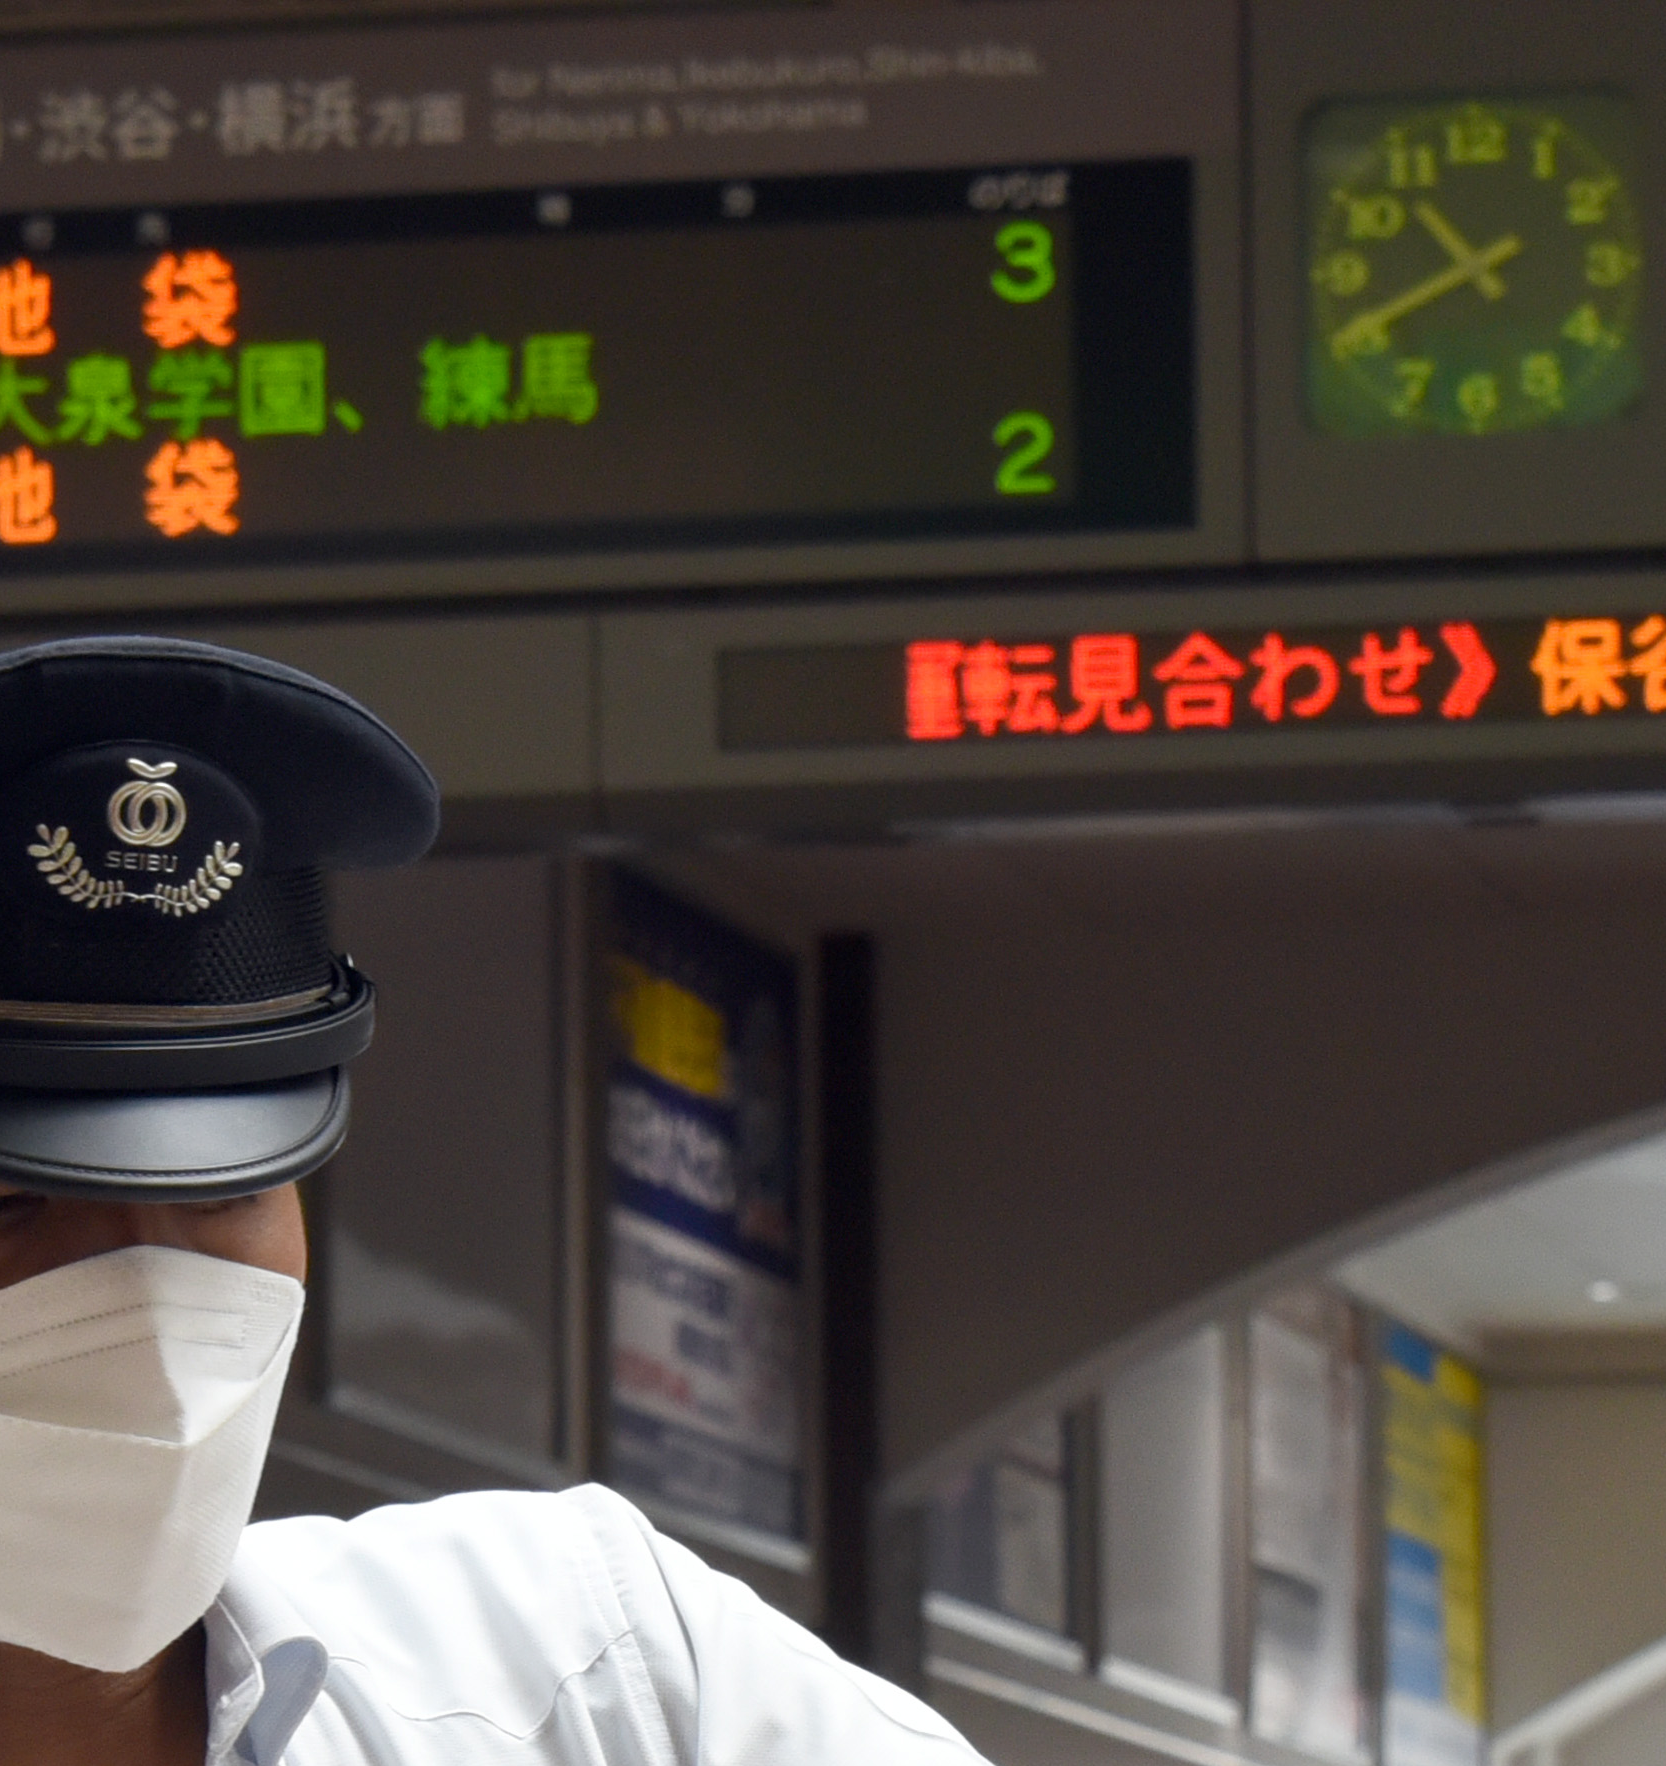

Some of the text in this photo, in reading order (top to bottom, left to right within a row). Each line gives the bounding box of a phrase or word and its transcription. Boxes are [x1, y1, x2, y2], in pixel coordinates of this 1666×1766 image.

[991, 221, 1056, 303] 3
[993, 412, 1055, 494] 2
[105, 851, 178, 873] SEIBU
